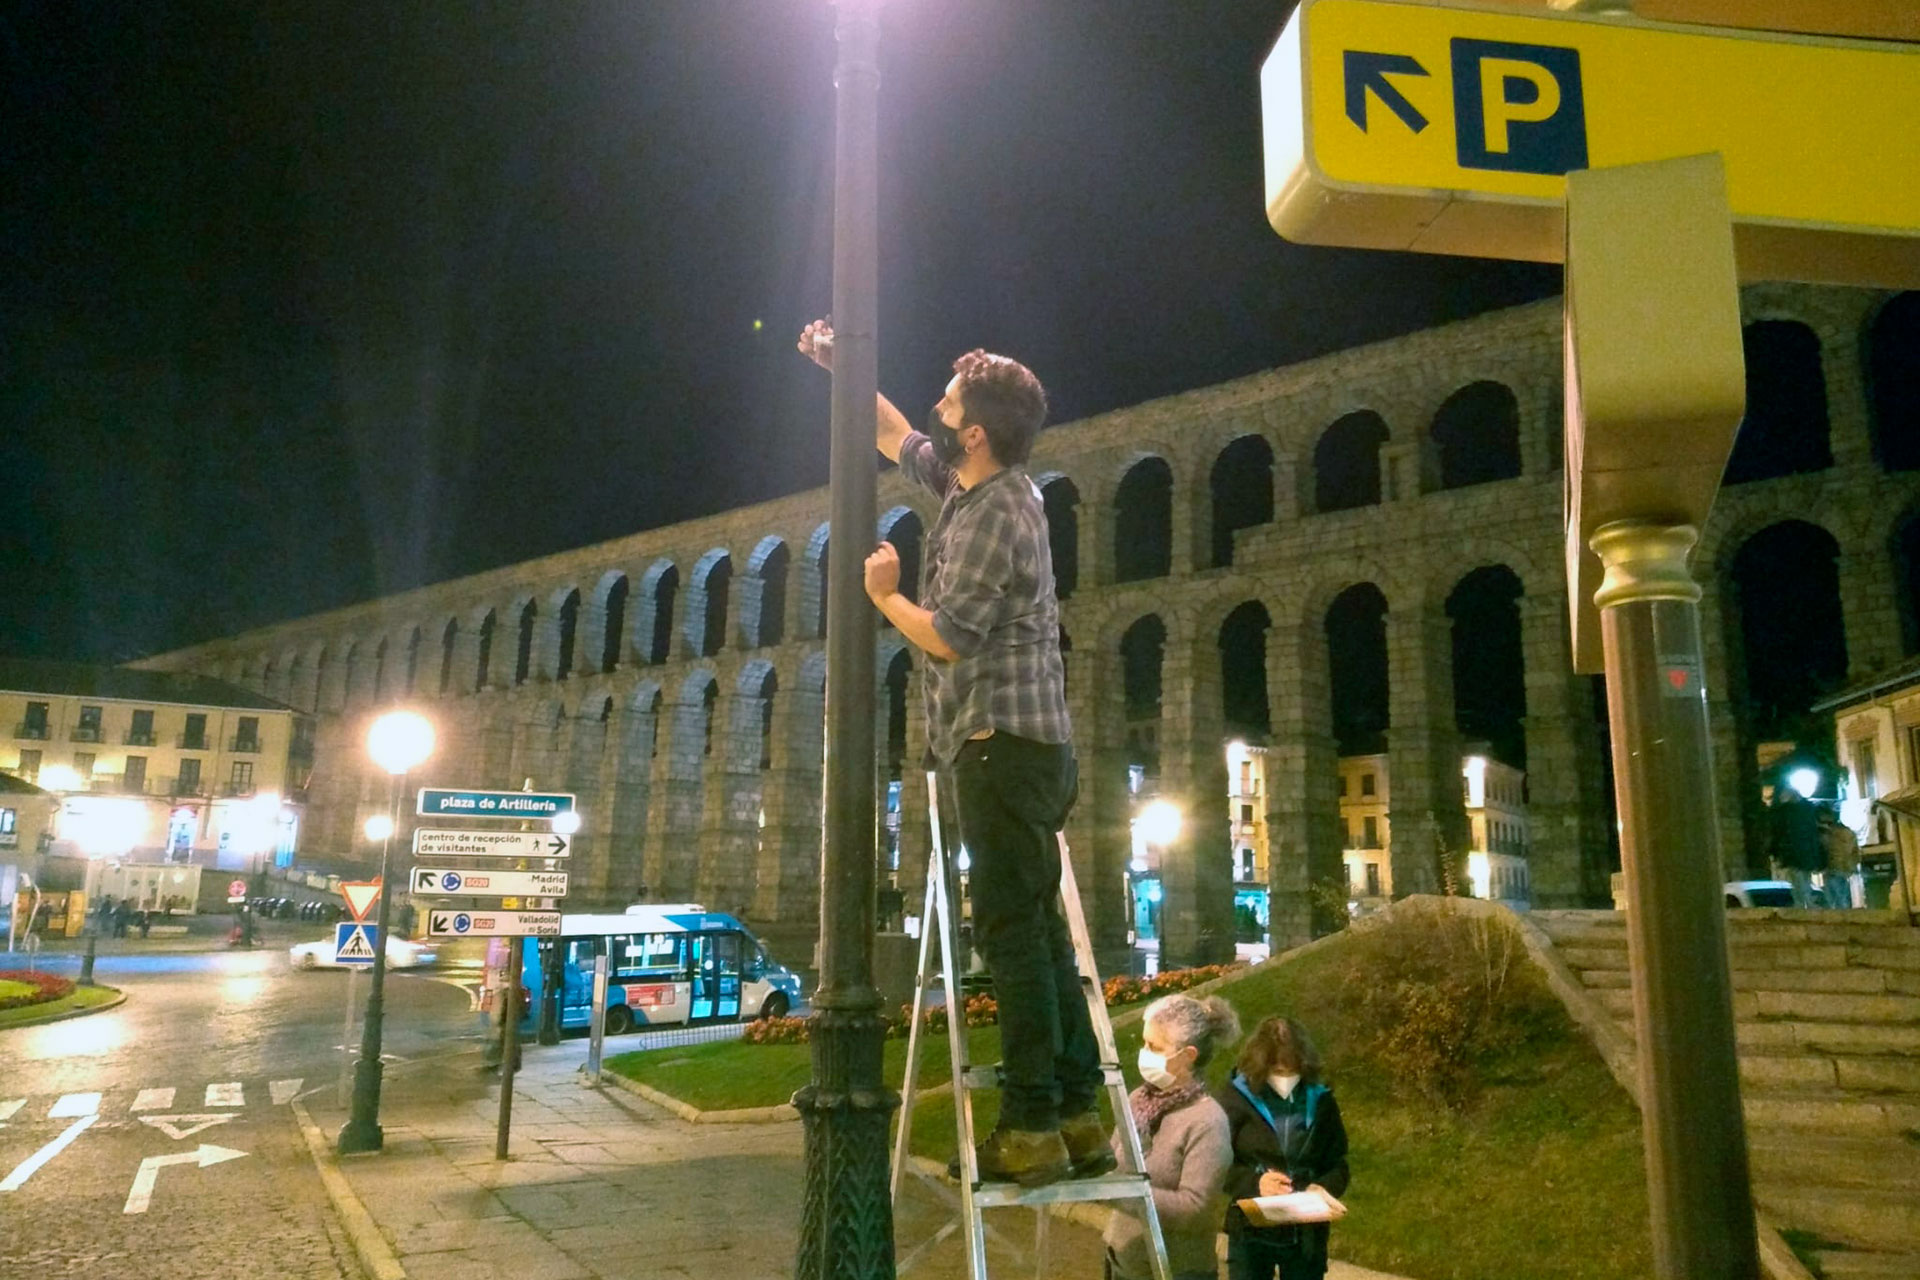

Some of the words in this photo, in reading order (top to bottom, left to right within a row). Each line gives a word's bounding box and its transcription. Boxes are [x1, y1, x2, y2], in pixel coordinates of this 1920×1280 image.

[1480, 57, 1560, 154] P
[440, 797, 475, 809] plaza
[479, 798, 495, 809] de
[422, 833, 455, 842] centro
[458, 834, 470, 842] de
[421, 844, 433, 852] de
[437, 844, 486, 852] visitantes
[531, 874, 565, 884] Madrid
[518, 915, 559, 924] Valladolid
[536, 926, 558, 934] Soria
